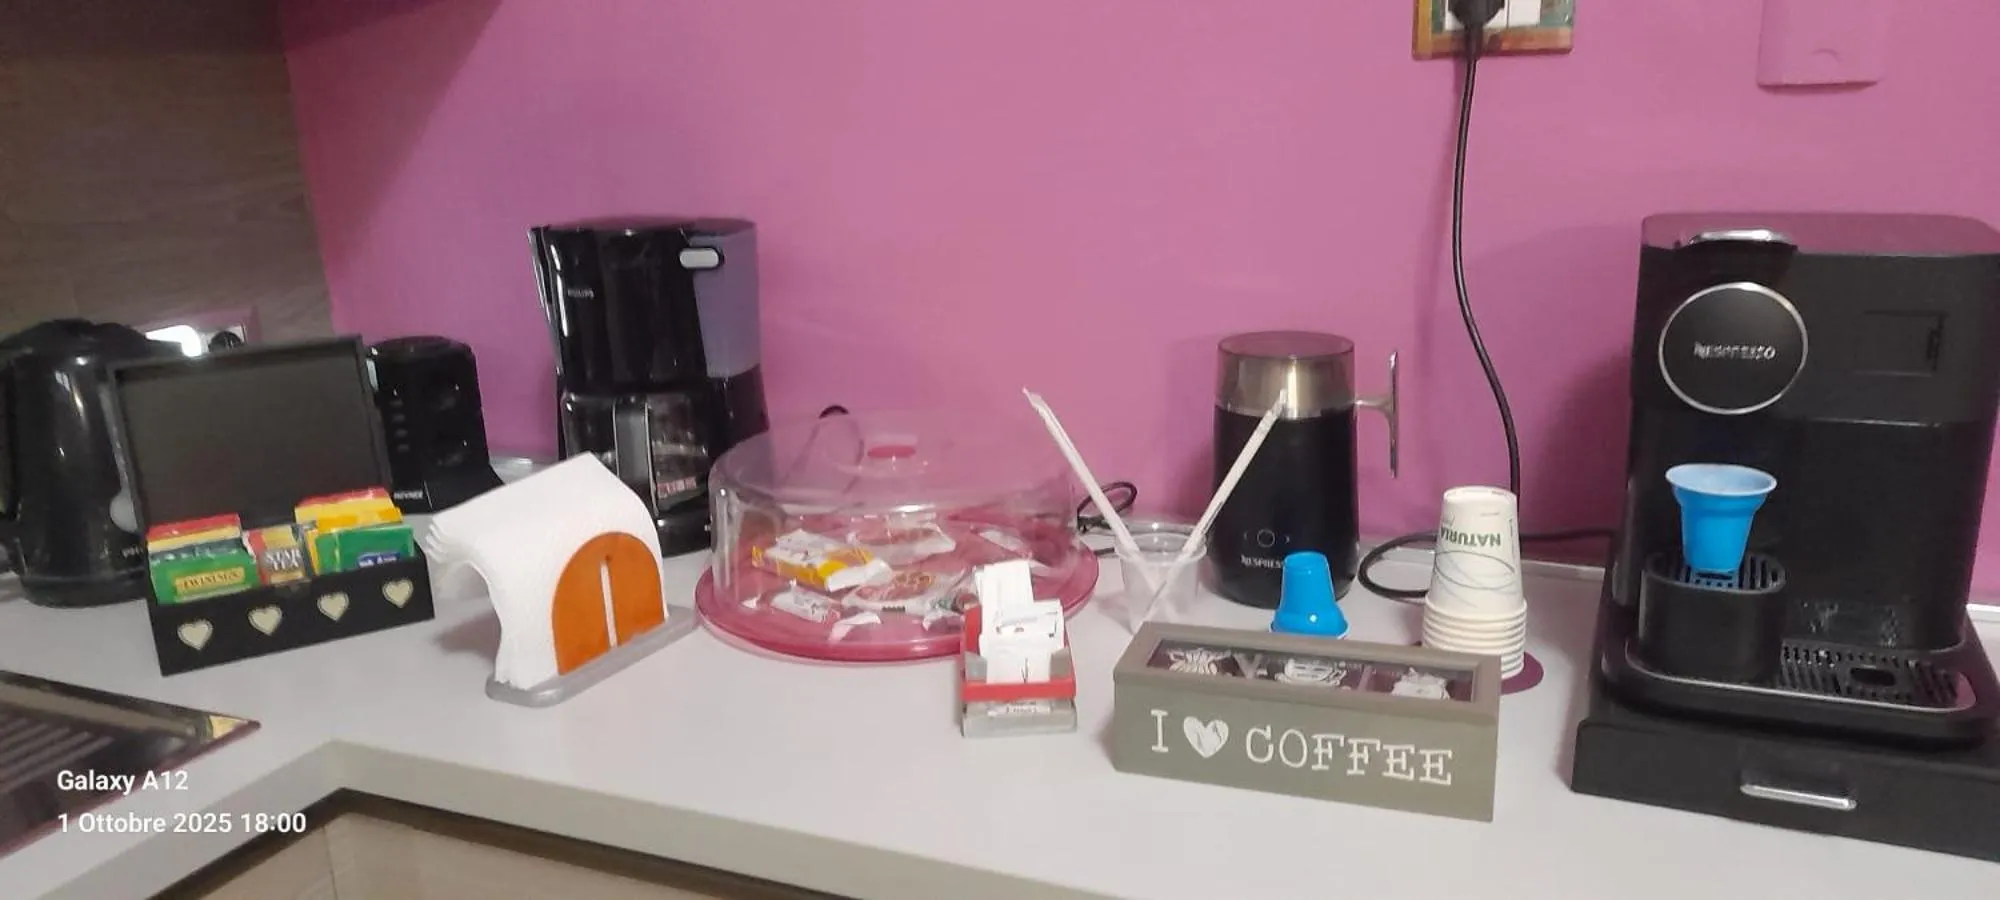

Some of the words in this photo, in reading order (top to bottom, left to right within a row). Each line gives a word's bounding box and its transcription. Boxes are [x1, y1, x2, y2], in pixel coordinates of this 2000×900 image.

[1693, 341, 1776, 360] NESPRESSO
[1150, 709, 1169, 753] I
[1246, 724, 1453, 786] COFFEE
